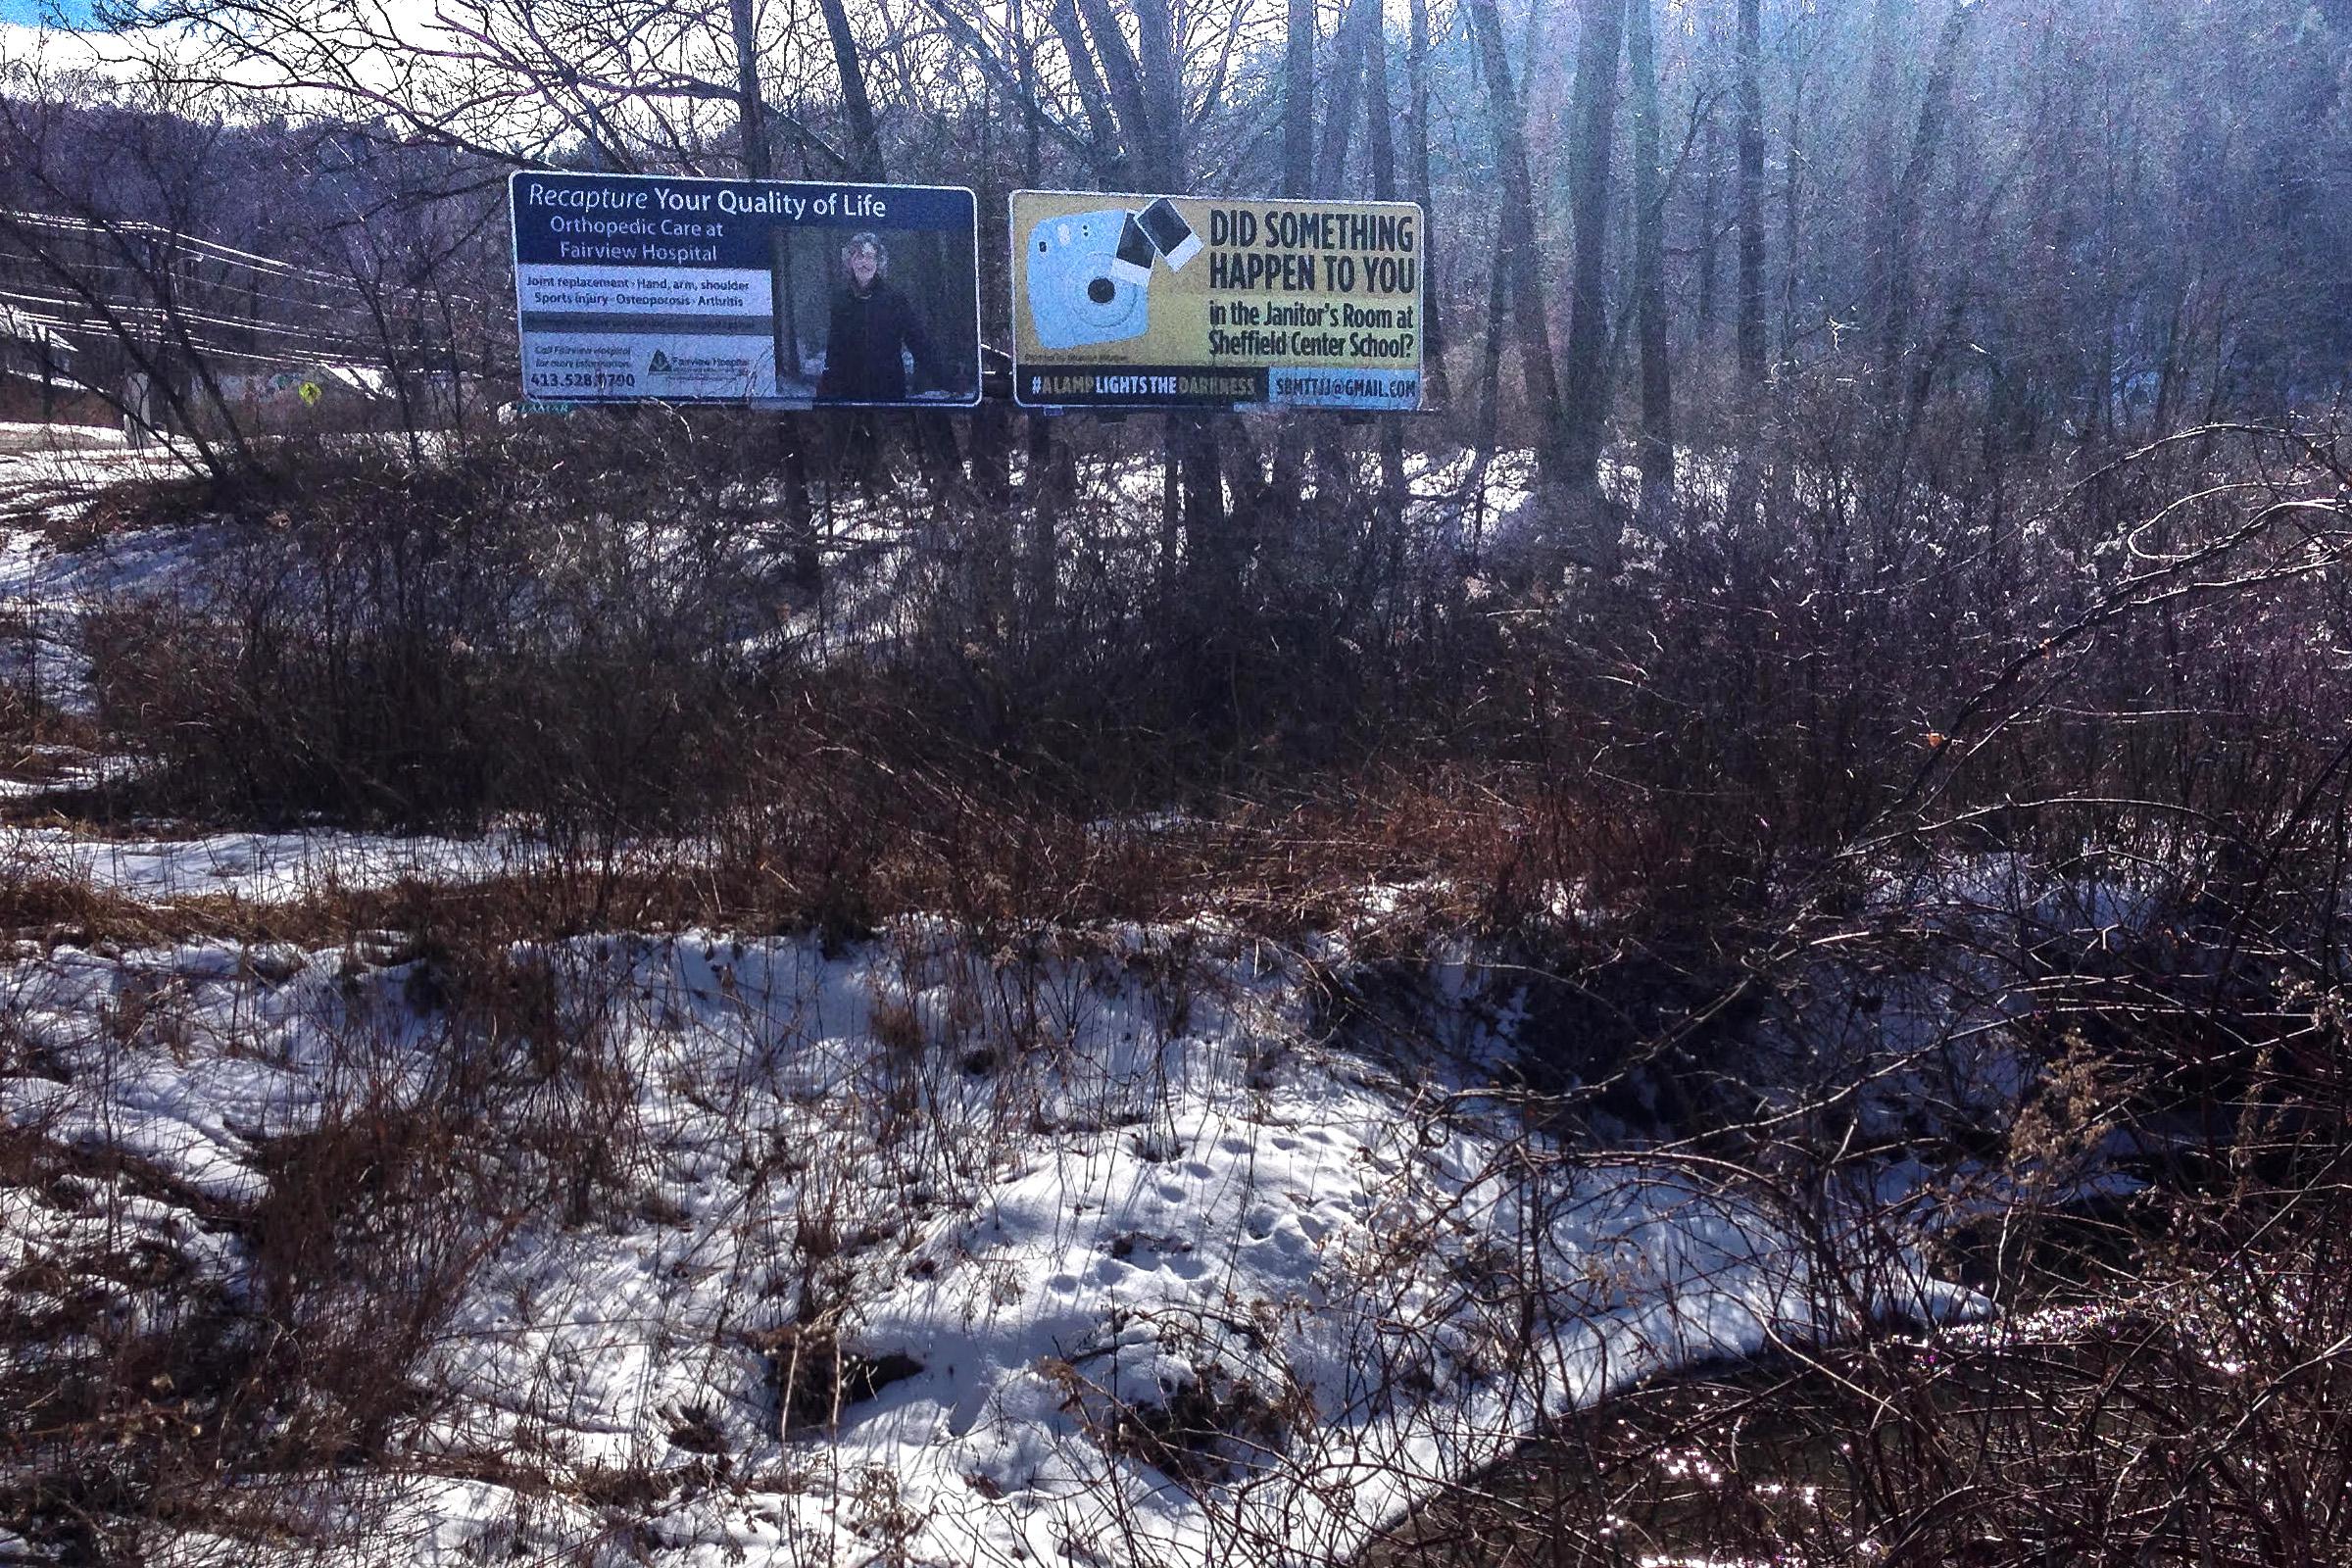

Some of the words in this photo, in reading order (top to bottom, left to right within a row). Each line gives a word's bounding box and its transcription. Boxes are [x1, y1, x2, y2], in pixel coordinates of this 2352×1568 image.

[529, 183, 648, 213] Recapture
[654, 187, 710, 211] Your
[717, 189, 807, 220] Quality
[813, 193, 837, 216] of
[844, 194, 886, 218] Life
[550, 216, 656, 238] Orthopedic
[661, 219, 702, 236] Care
[706, 221, 723, 237] at
[1210, 209, 1257, 247] DID
[1264, 211, 1414, 253] SOMETHING
[560, 241, 637, 261] Fairview
[642, 244, 717, 265] Hospital
[526, 276, 554, 287] Joint
[558, 277, 628, 289] replacement
[701, 280, 749, 291] shoulder
[1209, 252, 1315, 292] HAPPEN
[1324, 255, 1354, 293] TO
[1363, 256, 1415, 294] YOU
[534, 292, 572, 305] Sports
[575, 293, 608, 306] injury
[615, 294, 690, 308] Osteoporosis
[698, 296, 743, 307] Arthritis
[1209, 300, 1226, 324] in
[1231, 301, 1259, 325] the
[1263, 301, 1339, 328] Janitor's
[1343, 303, 1392, 329] Room
[1396, 306, 1414, 329] at
[1208, 328, 1287, 356] Sheffield
[1291, 330, 1346, 357] Center
[1349, 332, 1414, 359] School?
